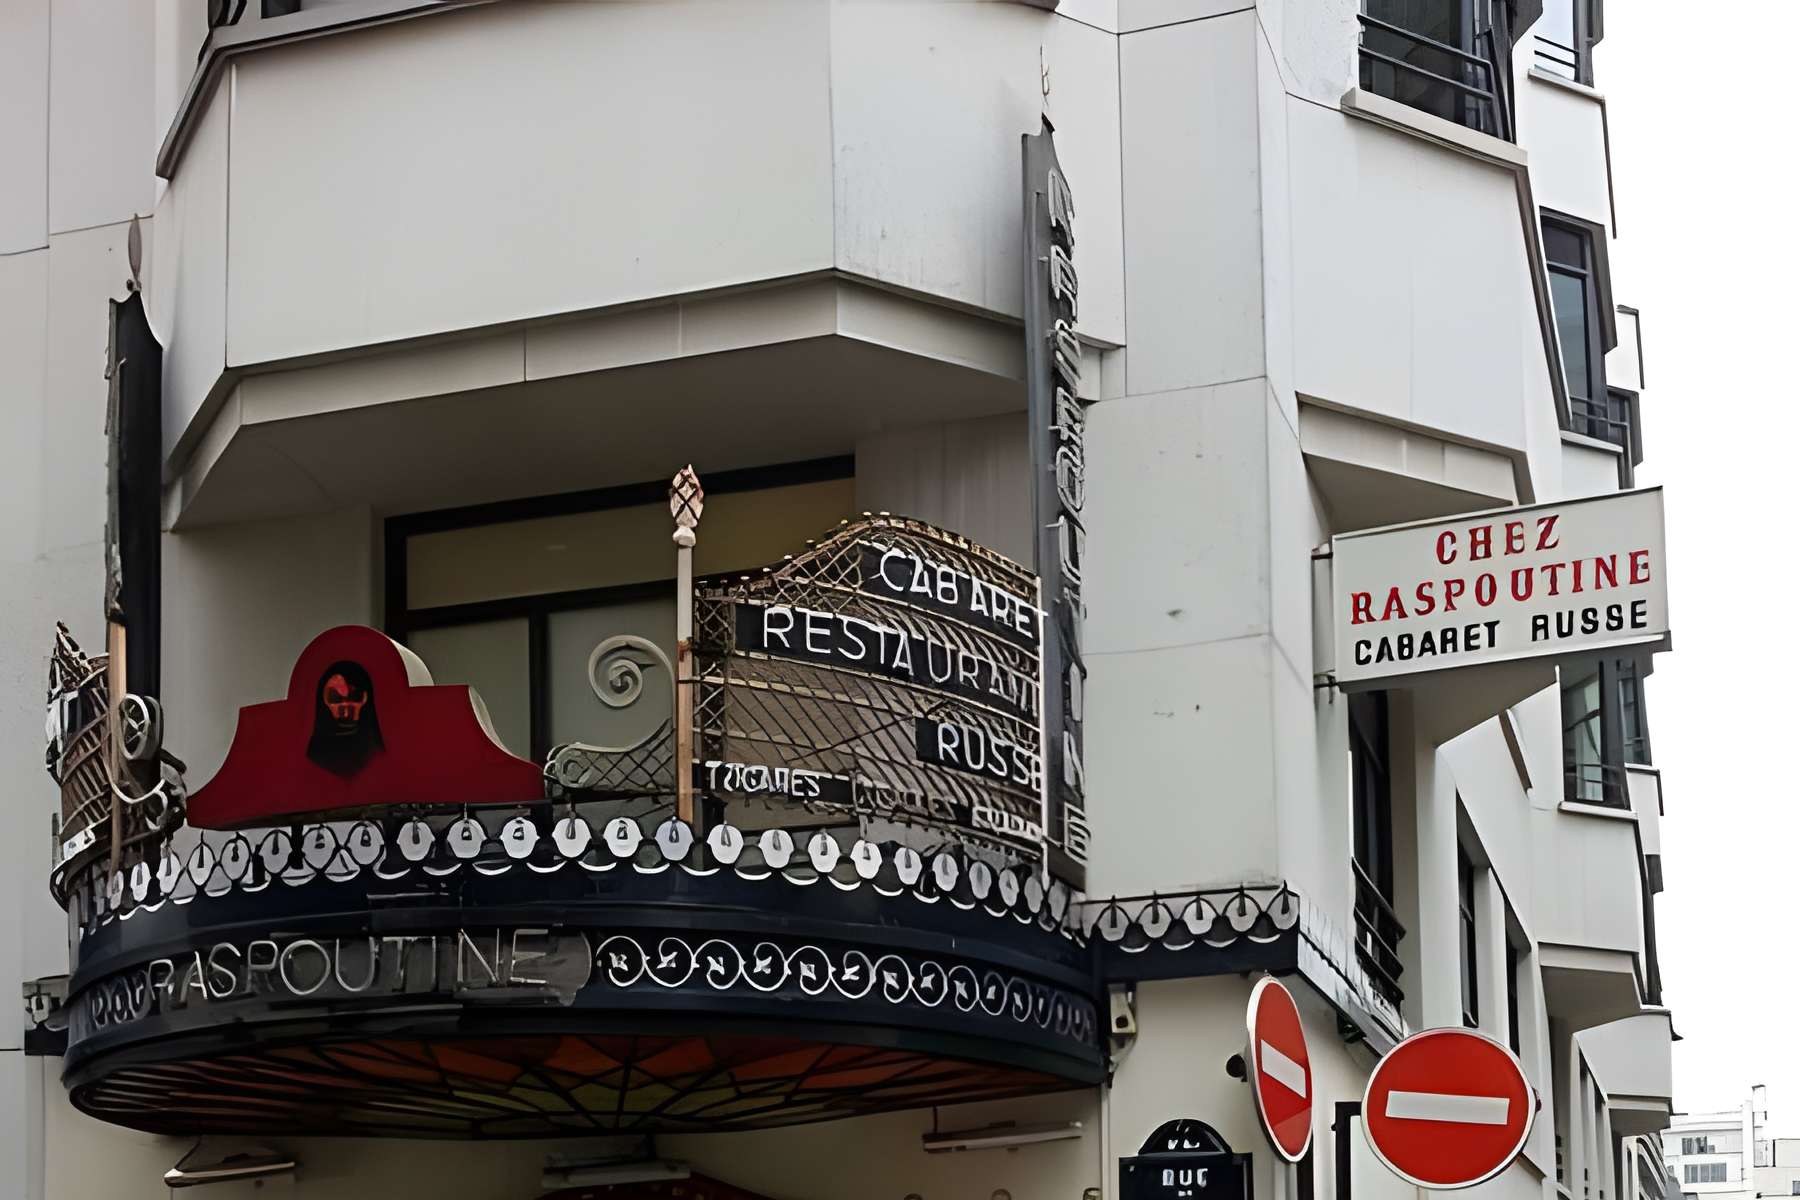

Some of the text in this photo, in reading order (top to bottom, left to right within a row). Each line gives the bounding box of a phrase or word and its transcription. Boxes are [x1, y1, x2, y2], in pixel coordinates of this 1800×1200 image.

[1436, 514, 1560, 565] CHEZ
[1351, 550, 1650, 625] RASPOUTINE
[1355, 600, 1647, 665] CABARET RUSSE
[146, 928, 550, 1004] RASPOUTINE
